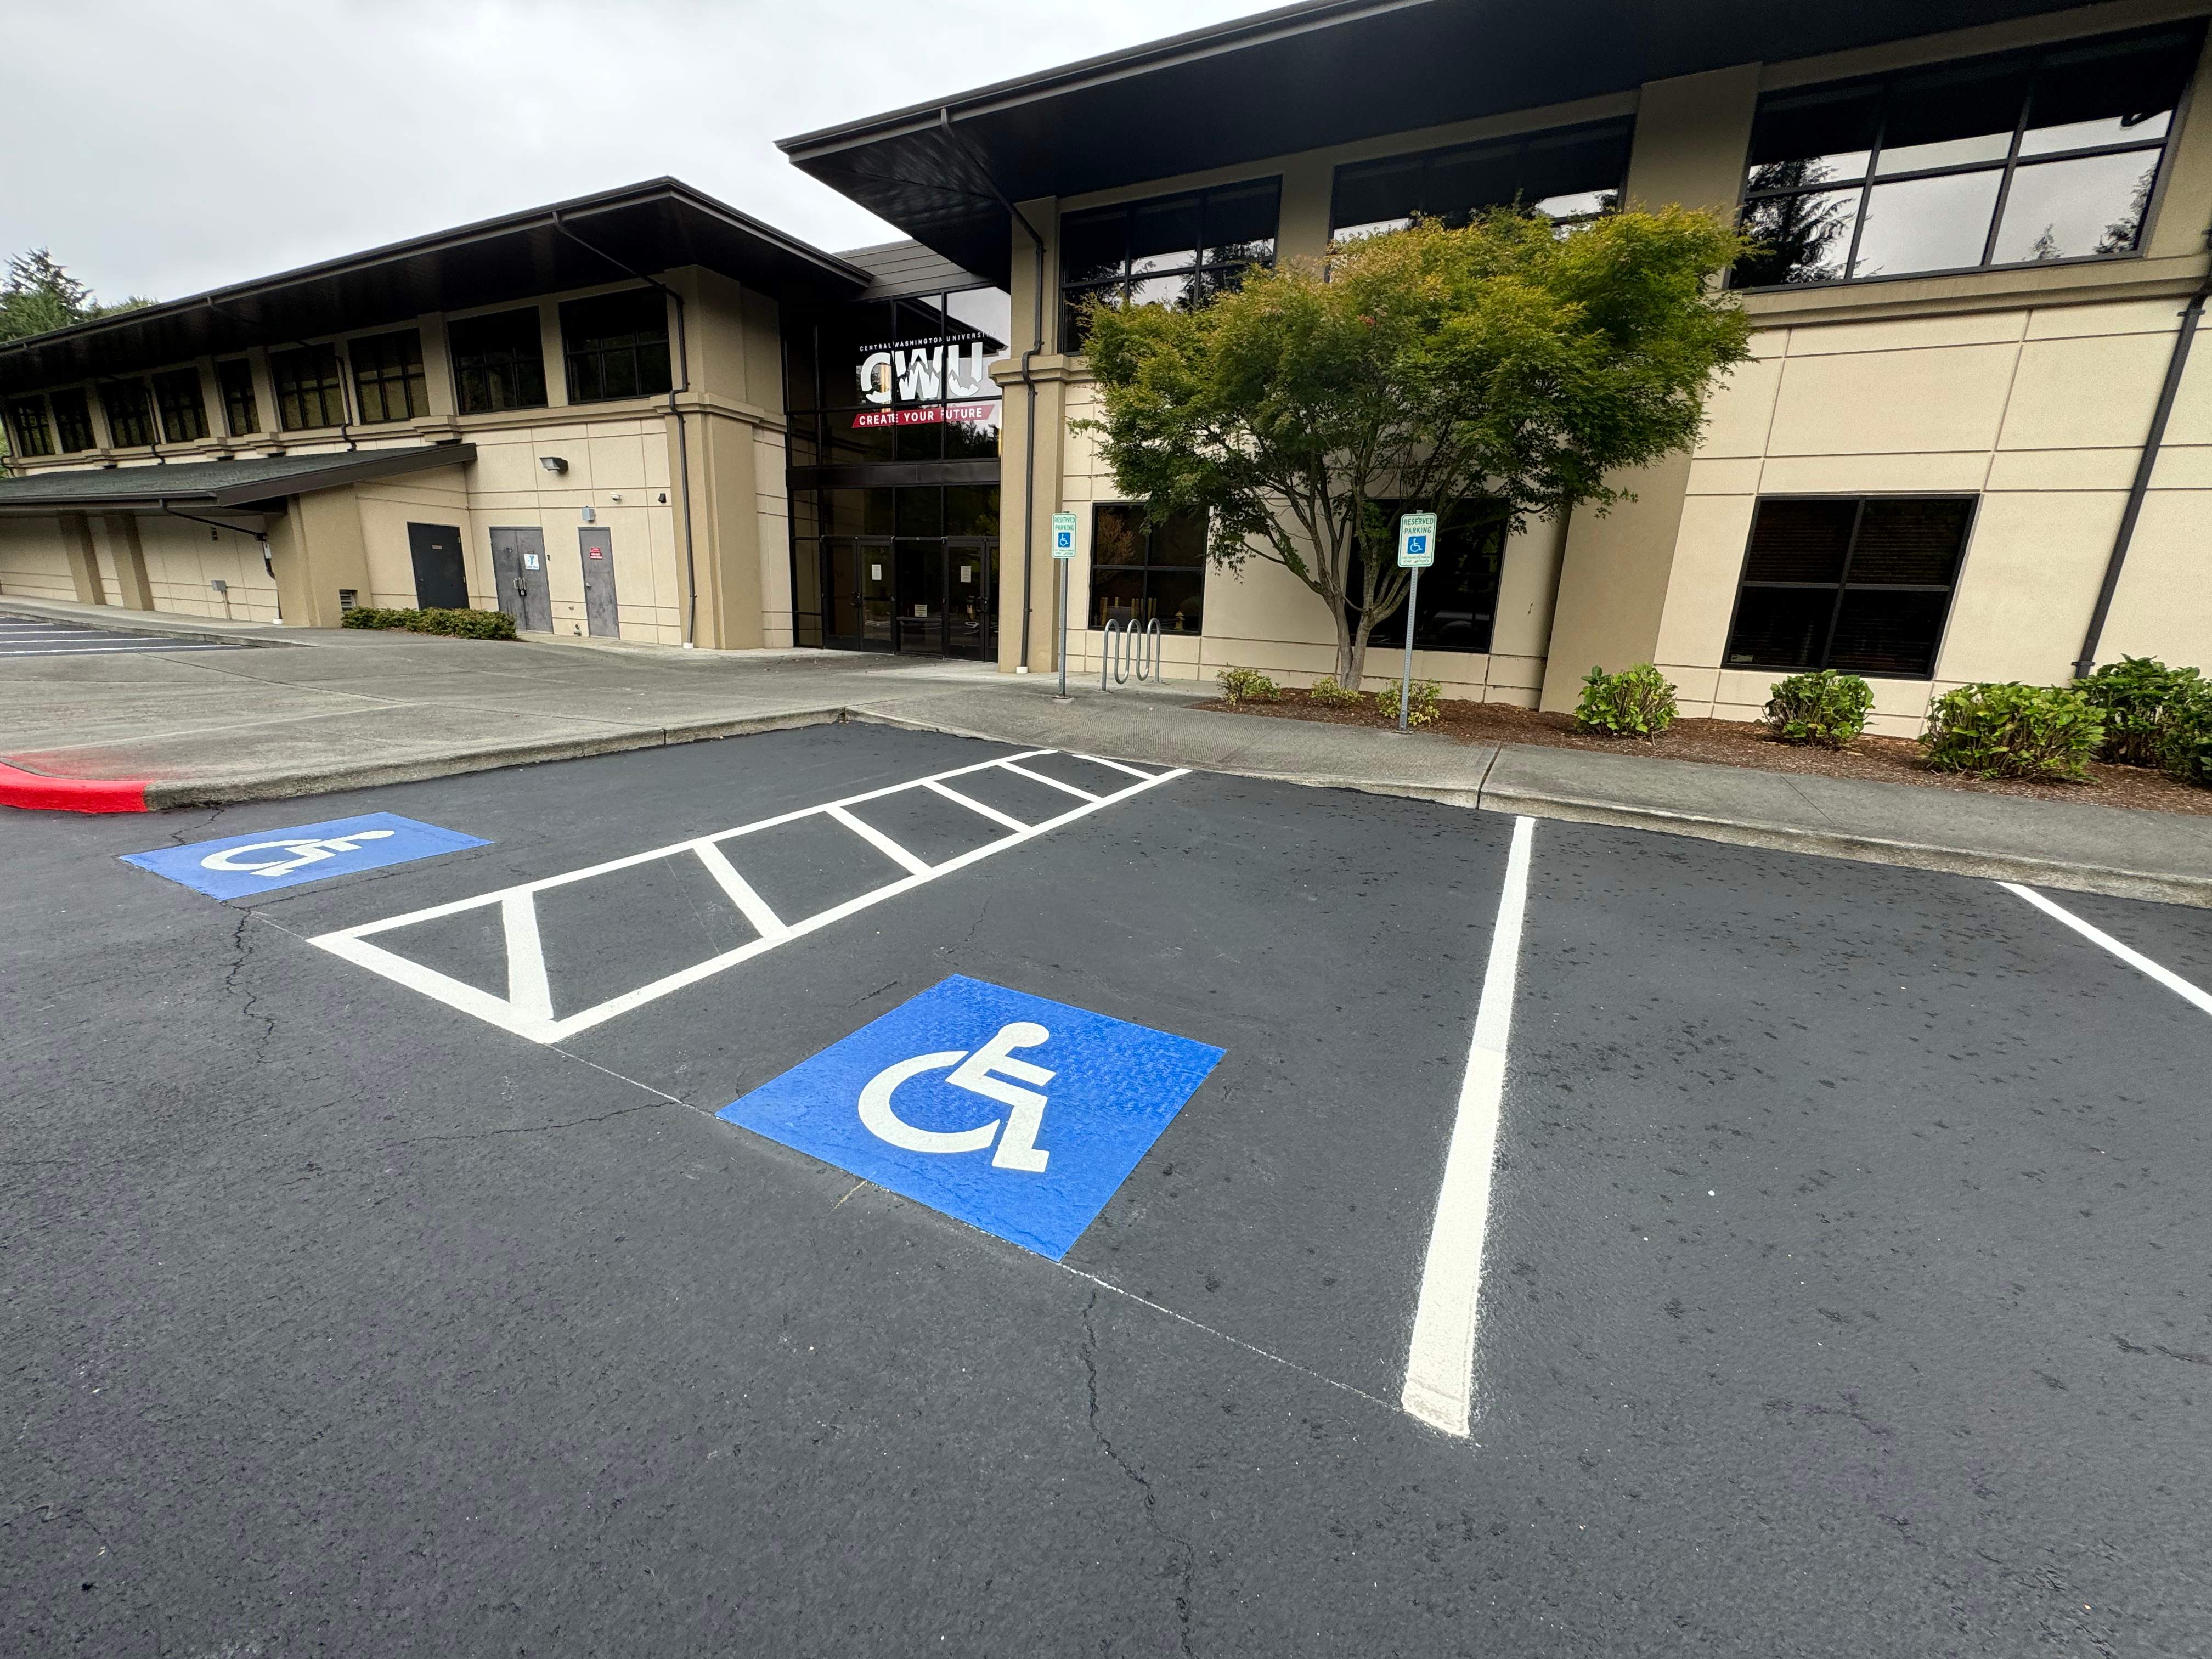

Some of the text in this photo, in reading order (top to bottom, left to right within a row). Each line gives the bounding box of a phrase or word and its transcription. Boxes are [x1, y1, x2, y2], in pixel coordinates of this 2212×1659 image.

[860, 343, 891, 352] CENTRAL
[859, 408, 983, 425] CREATE YOUR FUTURE
[1403, 517, 1434, 526] RESERVED
